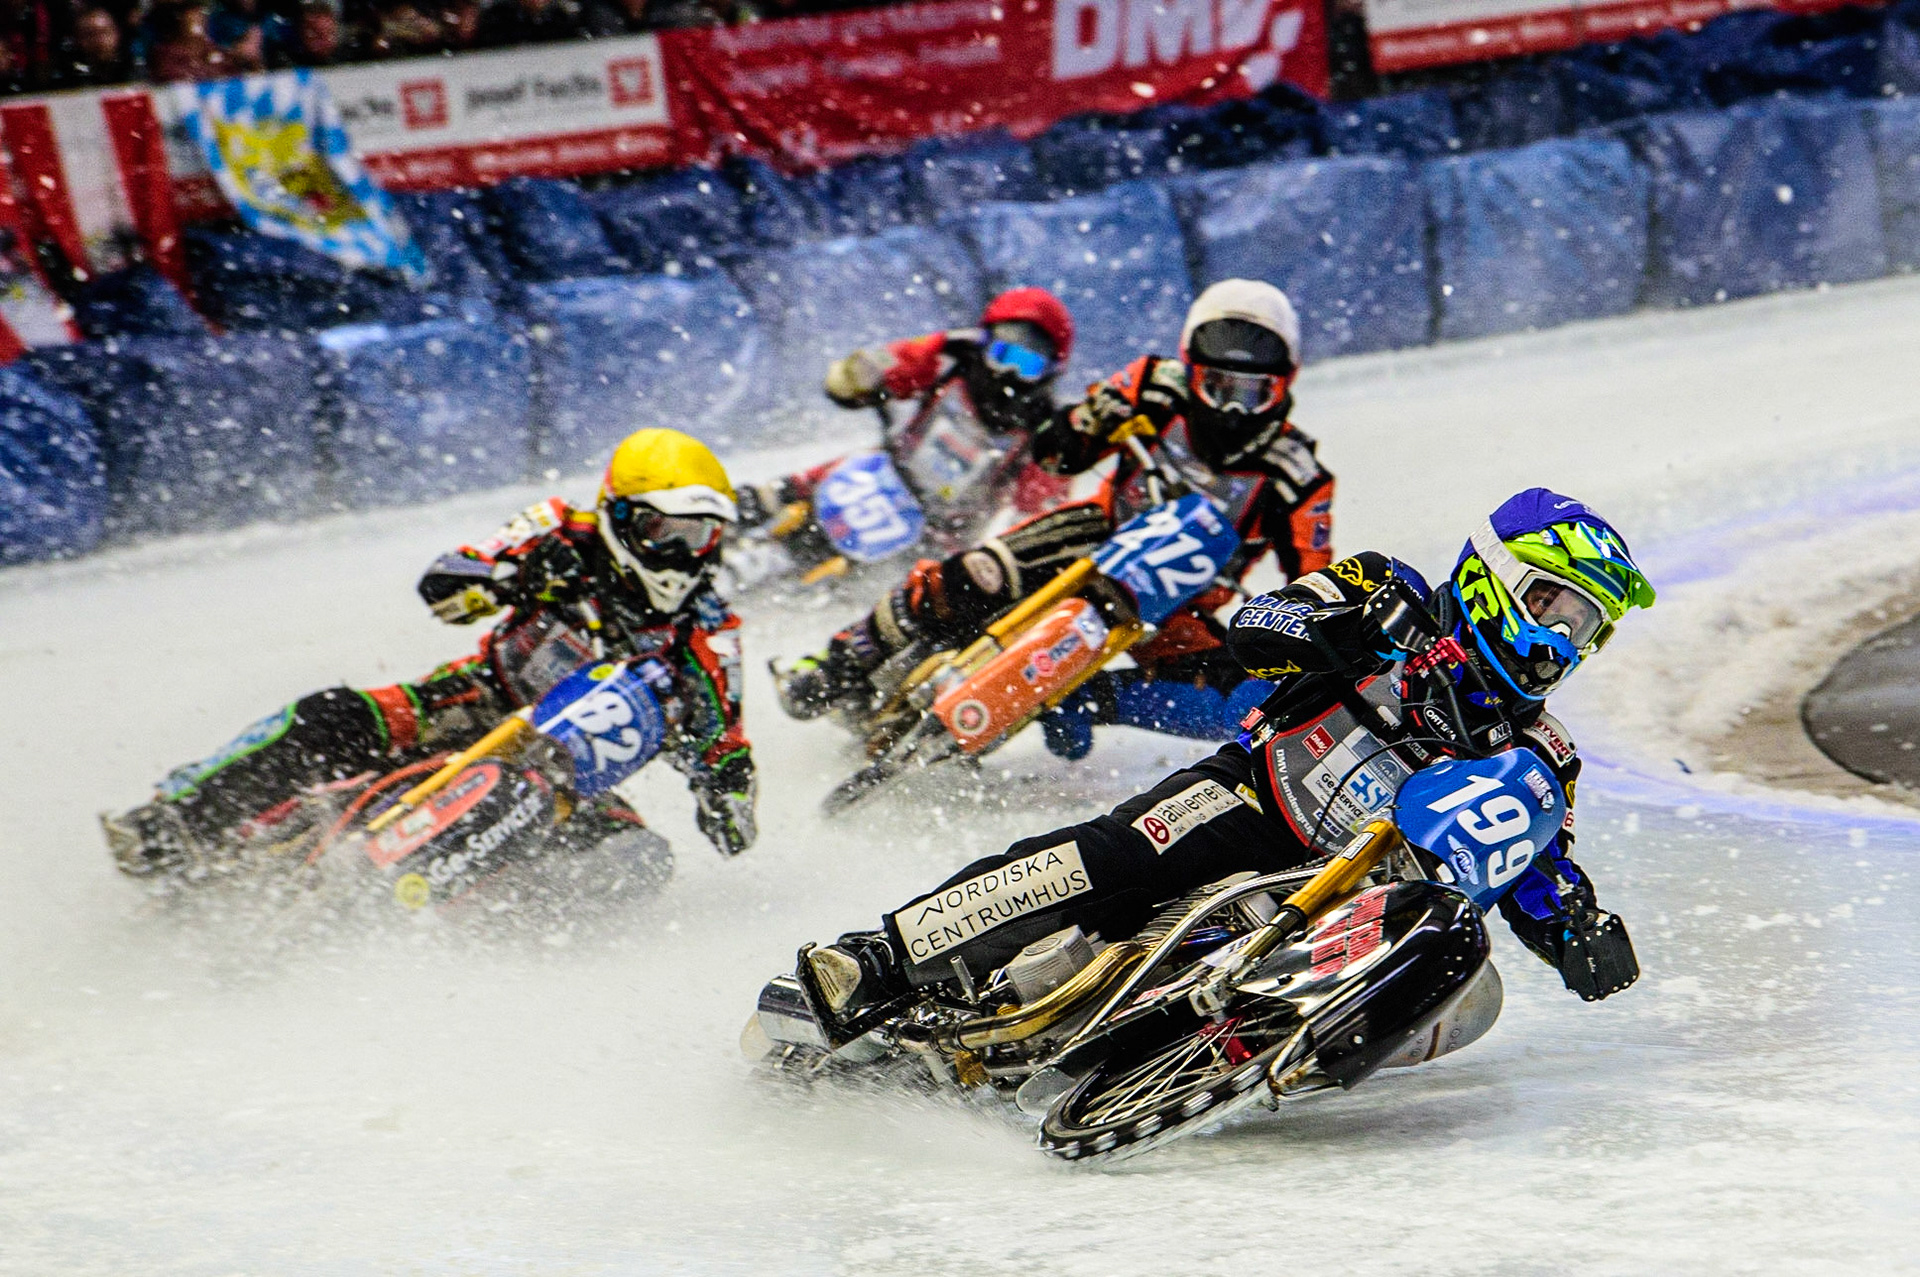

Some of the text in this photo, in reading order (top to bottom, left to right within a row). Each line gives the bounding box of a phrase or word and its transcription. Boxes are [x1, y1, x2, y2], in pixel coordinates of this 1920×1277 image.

[1275, 748, 1287, 774] DMV
[1415, 774, 1536, 889] 199
[910, 869, 1087, 958] CENTRUMHUS
[916, 851, 1064, 926] NORDISKA
